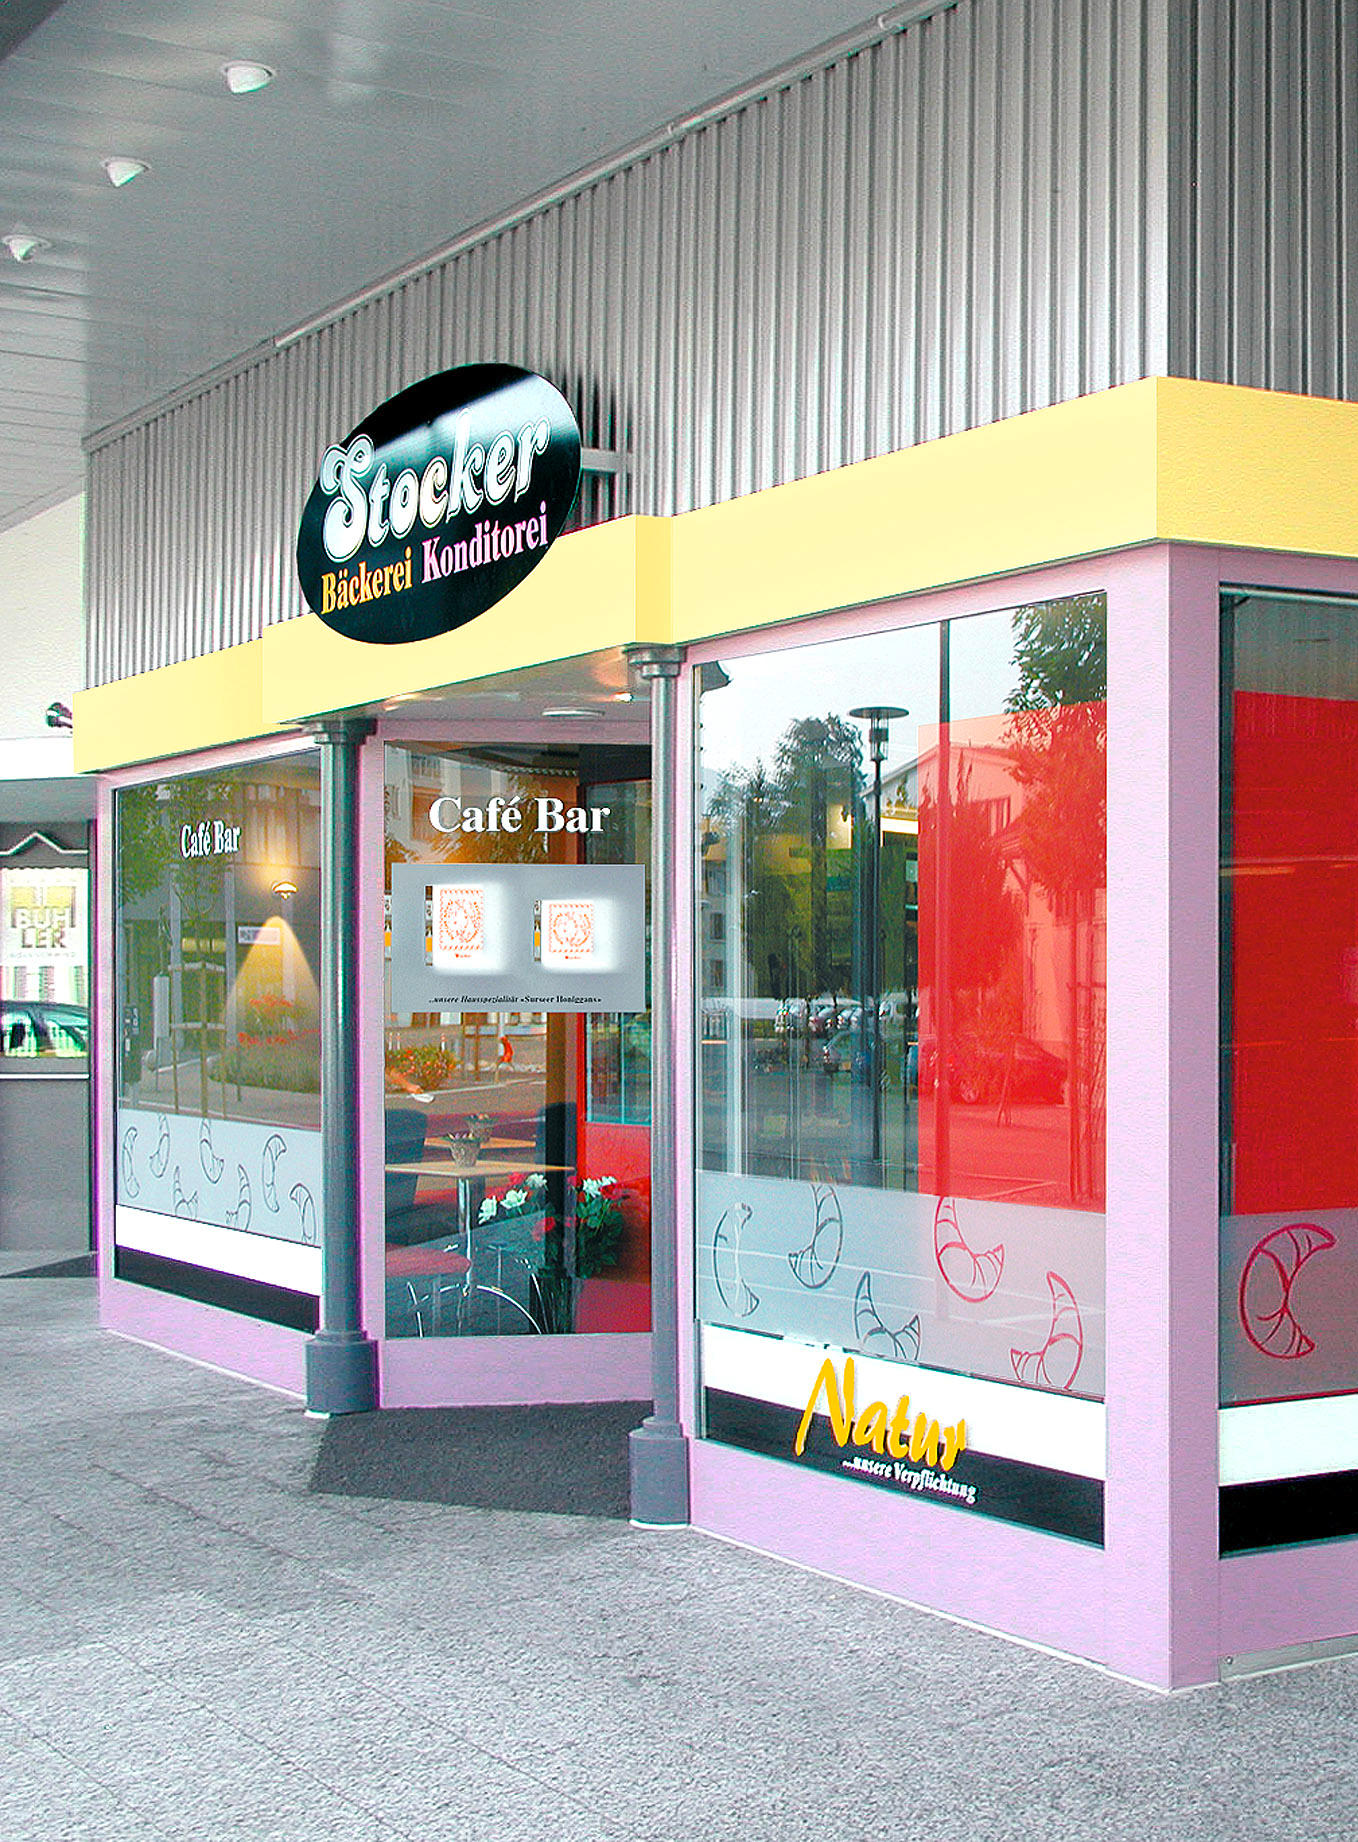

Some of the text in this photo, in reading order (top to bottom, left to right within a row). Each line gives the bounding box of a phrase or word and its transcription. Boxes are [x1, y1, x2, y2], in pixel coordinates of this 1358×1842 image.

[319, 406, 551, 563] Stocker
[321, 500, 548, 615] Bäckerei Konditorei
[180, 820, 241, 859] Café Bar
[428, 796, 611, 834] Café Bar
[795, 1356, 967, 1472] Natur
[893, 1462, 978, 1503] Verpflichtung
